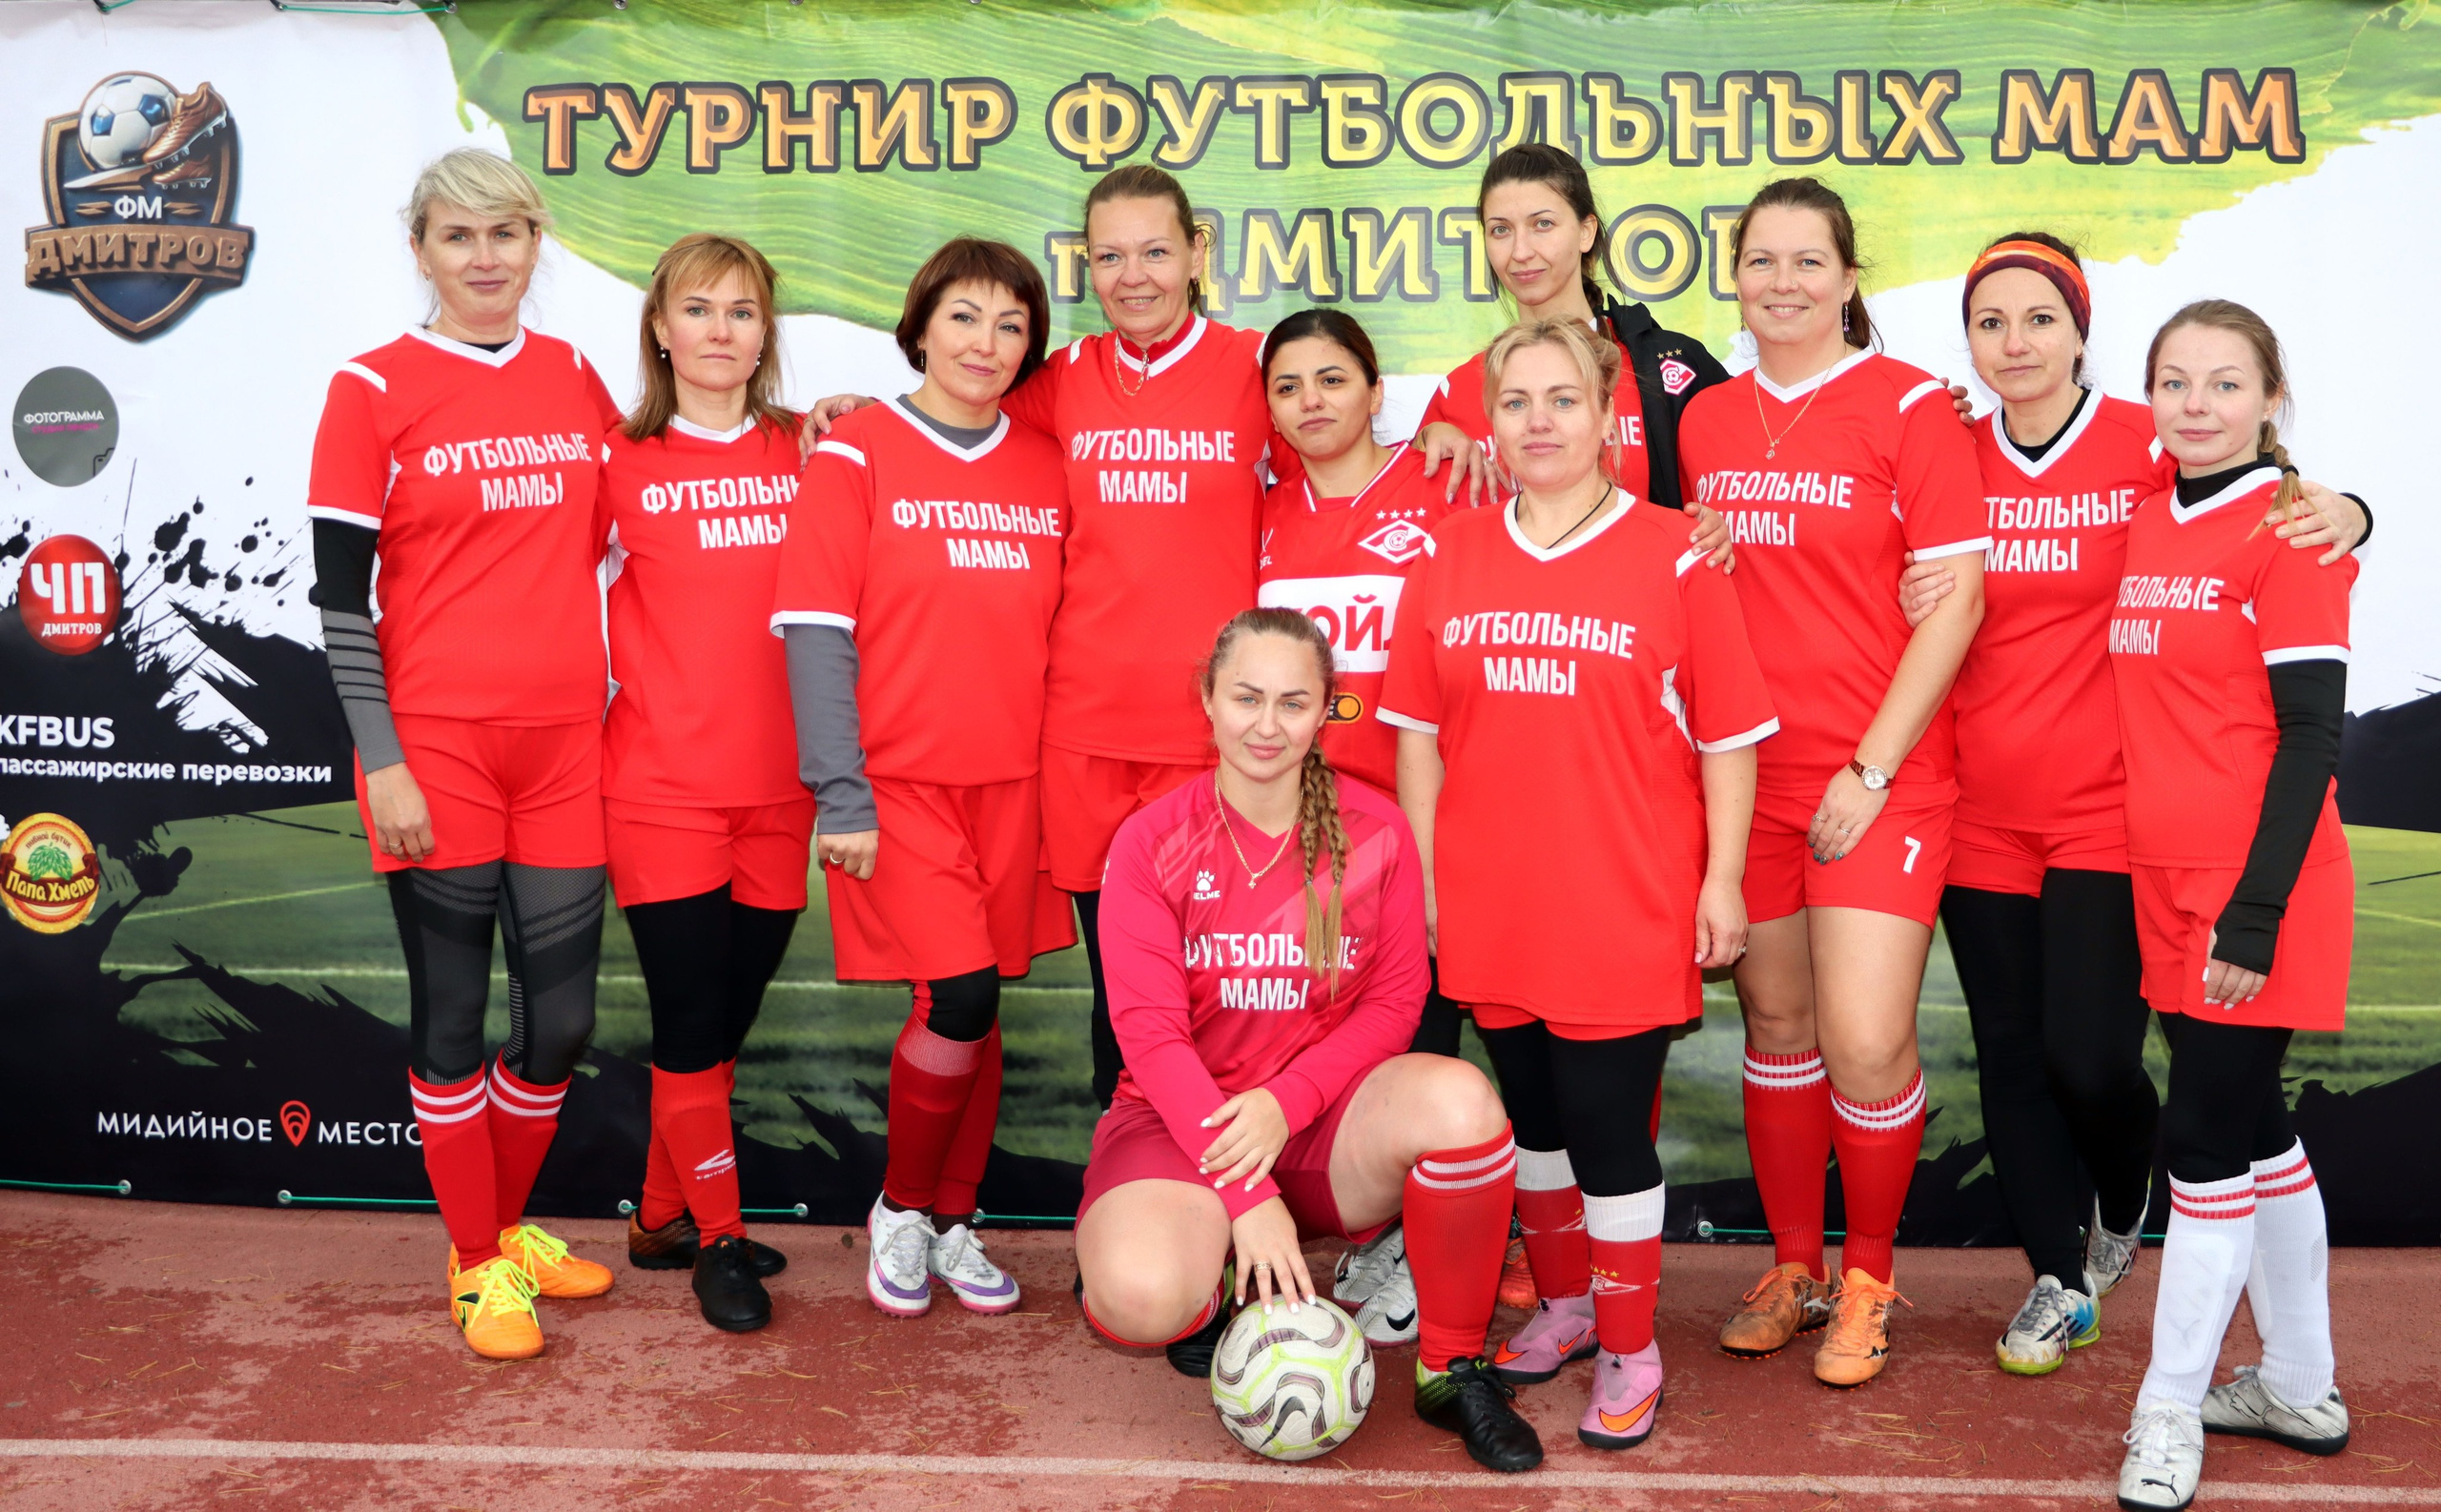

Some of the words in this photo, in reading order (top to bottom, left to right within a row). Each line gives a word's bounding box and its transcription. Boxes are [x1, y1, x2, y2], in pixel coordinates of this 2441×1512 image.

[523, 78, 1018, 176] ТУРНИР
[1045, 71, 1964, 172] ФУТБОЛЬНЫХ
[1992, 68, 2306, 164] МАМ
[114, 195, 162, 219] ФМ
[29, 233, 247, 276] ДМИТРОВ
[1192, 204, 1739, 318] МИТО
[24, 410, 105, 424] ФОТОГРАММА
[423, 433, 592, 477] ФУТБОЛЬНЫЕ
[1071, 428, 1236, 462] ФУТБОЛЬНЫЕ
[481, 472, 564, 512] МАМЫ
[641, 475, 800, 515] ФУТБОЛЬН
[1098, 470, 1188, 503] МАМЫ
[1696, 471, 1855, 509] ФУТБОЛЬНЫЕ
[892, 498, 1062, 537] ФУТБОЛЬНЫЕ
[1983, 488, 2135, 529] ТБОЛЬНЫЕ
[697, 513, 788, 549] МАМЫ
[946, 538, 1031, 570] МАМЫ
[1984, 537, 2079, 572] МАМЫ
[31, 562, 106, 614] ЧП
[2116, 576, 2226, 611] ТБОЛЬНЫЕ
[41, 623, 102, 638] ДМИТРОВ
[1443, 611, 1636, 659] ФУТБОЛЬНЫЕ
[2108, 619, 2162, 655] МАМЫ
[1483, 657, 1576, 696] МАМЫ
[182, 764, 332, 786] перевозки
[51, 831, 72, 849] бутик
[1903, 835, 1921, 874] 7
[6, 869, 47, 901] Папа
[1193, 890, 1220, 900] ELME
[1220, 977, 1310, 1011] МАМЫ
[98, 1109, 273, 1142] МИДИЙНОЕ
